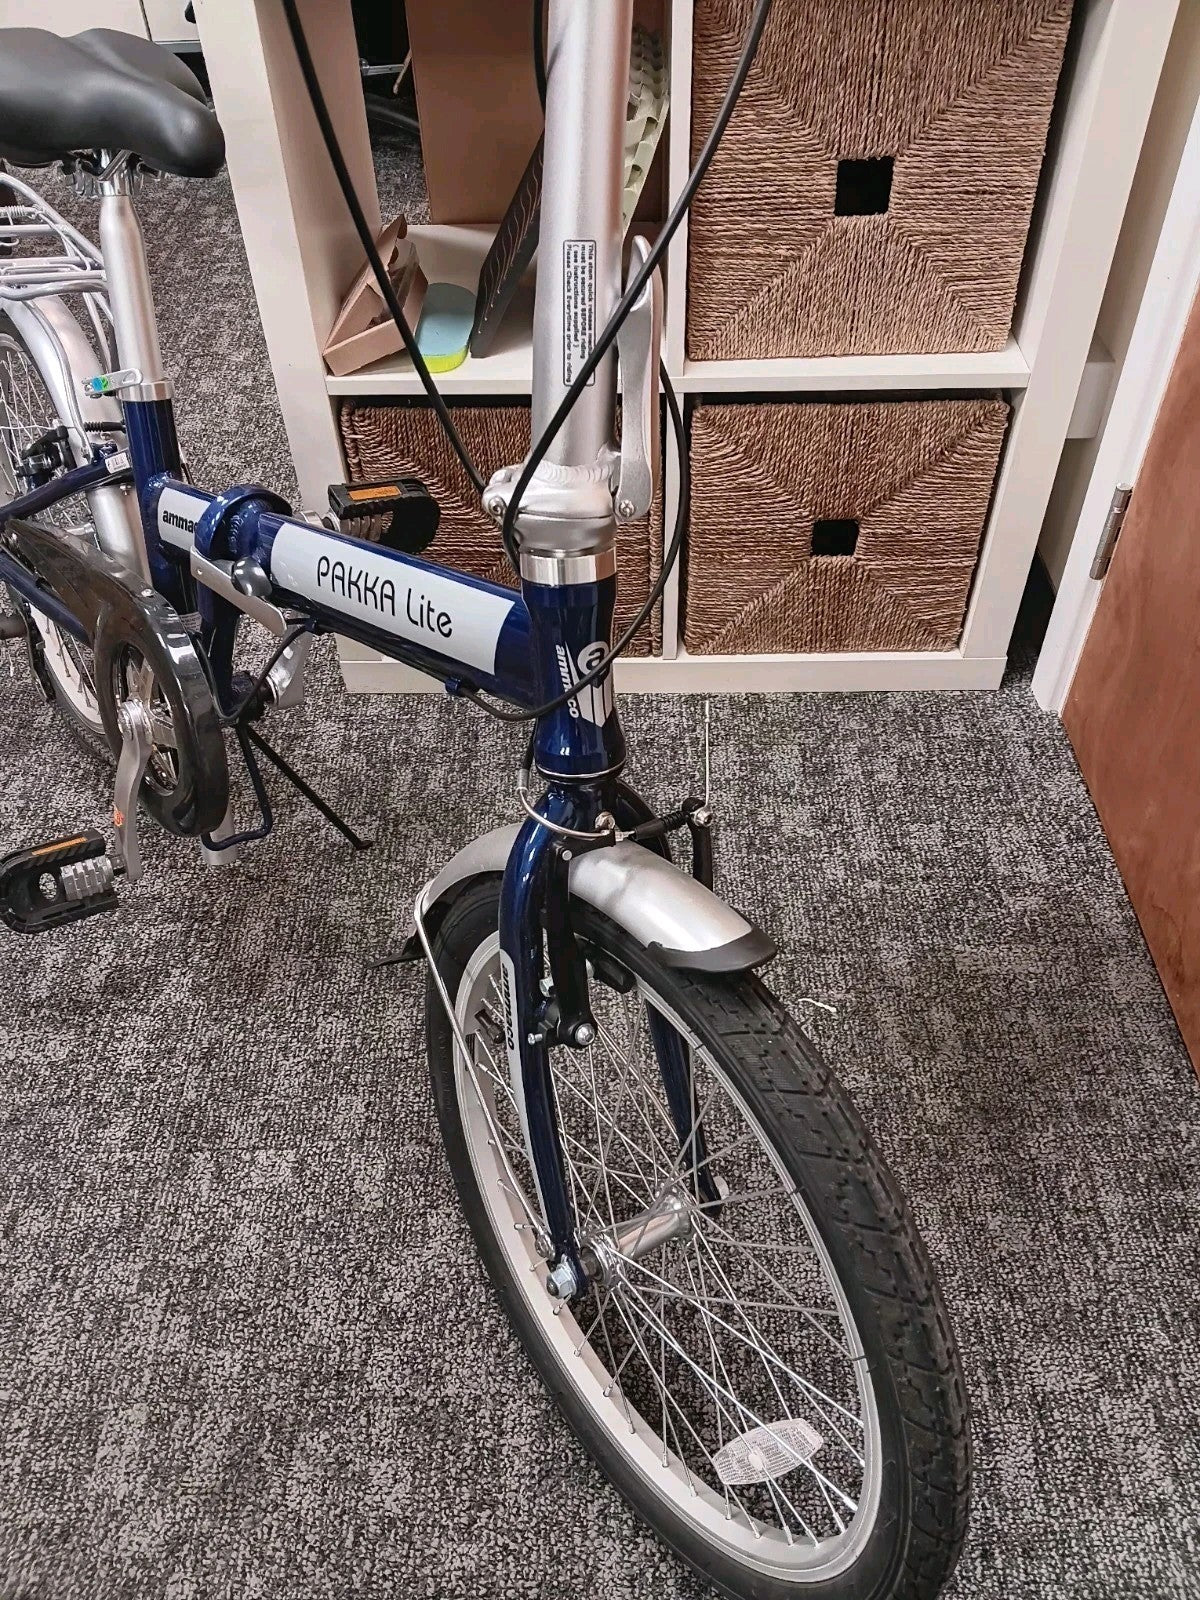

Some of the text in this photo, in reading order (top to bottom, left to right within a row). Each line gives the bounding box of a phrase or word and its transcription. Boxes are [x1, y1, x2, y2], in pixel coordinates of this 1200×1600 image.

[581, 265, 587, 275] be
[162, 510, 198, 534] amma
[317, 555, 452, 638] PAKKA Lite
[555, 644, 580, 719] ammco
